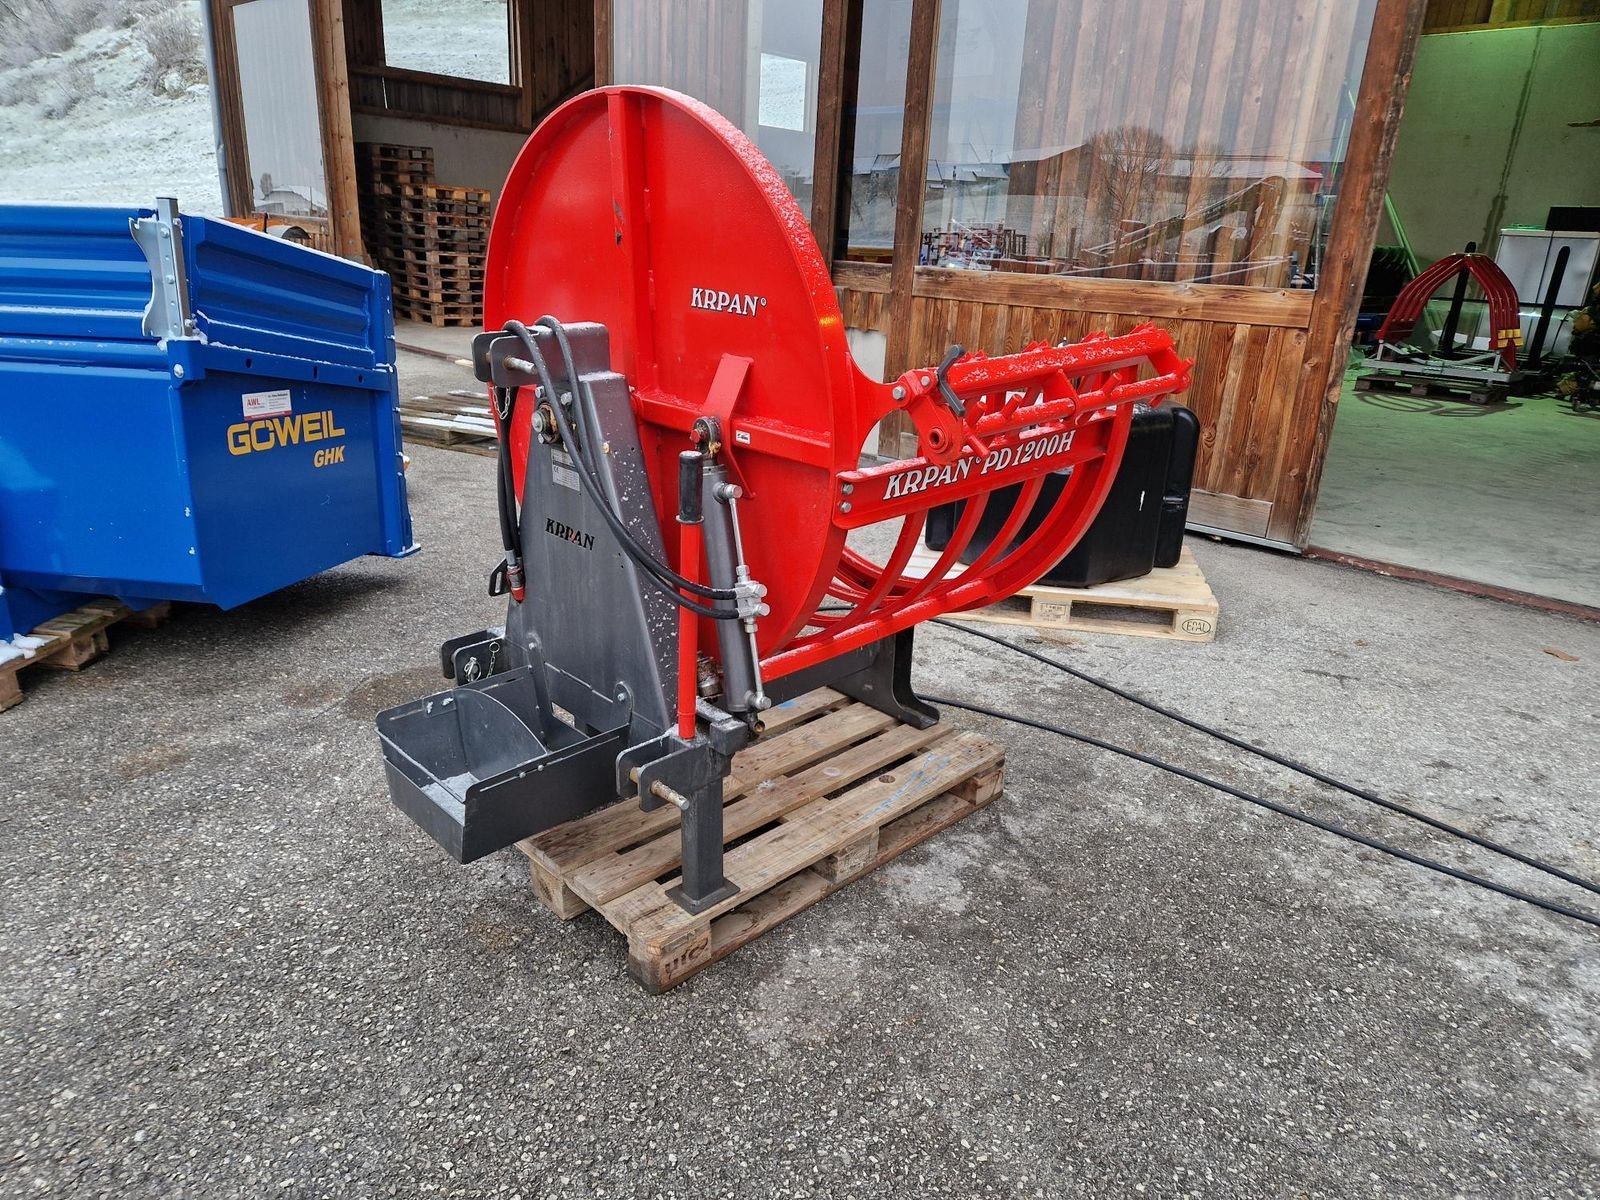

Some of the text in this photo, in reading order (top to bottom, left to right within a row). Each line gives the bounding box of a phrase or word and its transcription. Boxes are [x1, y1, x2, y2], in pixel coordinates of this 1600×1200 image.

[313, 445, 345, 468] GHK
[545, 518, 596, 551] KRPAN
[1186, 620, 1209, 633] EPAL
